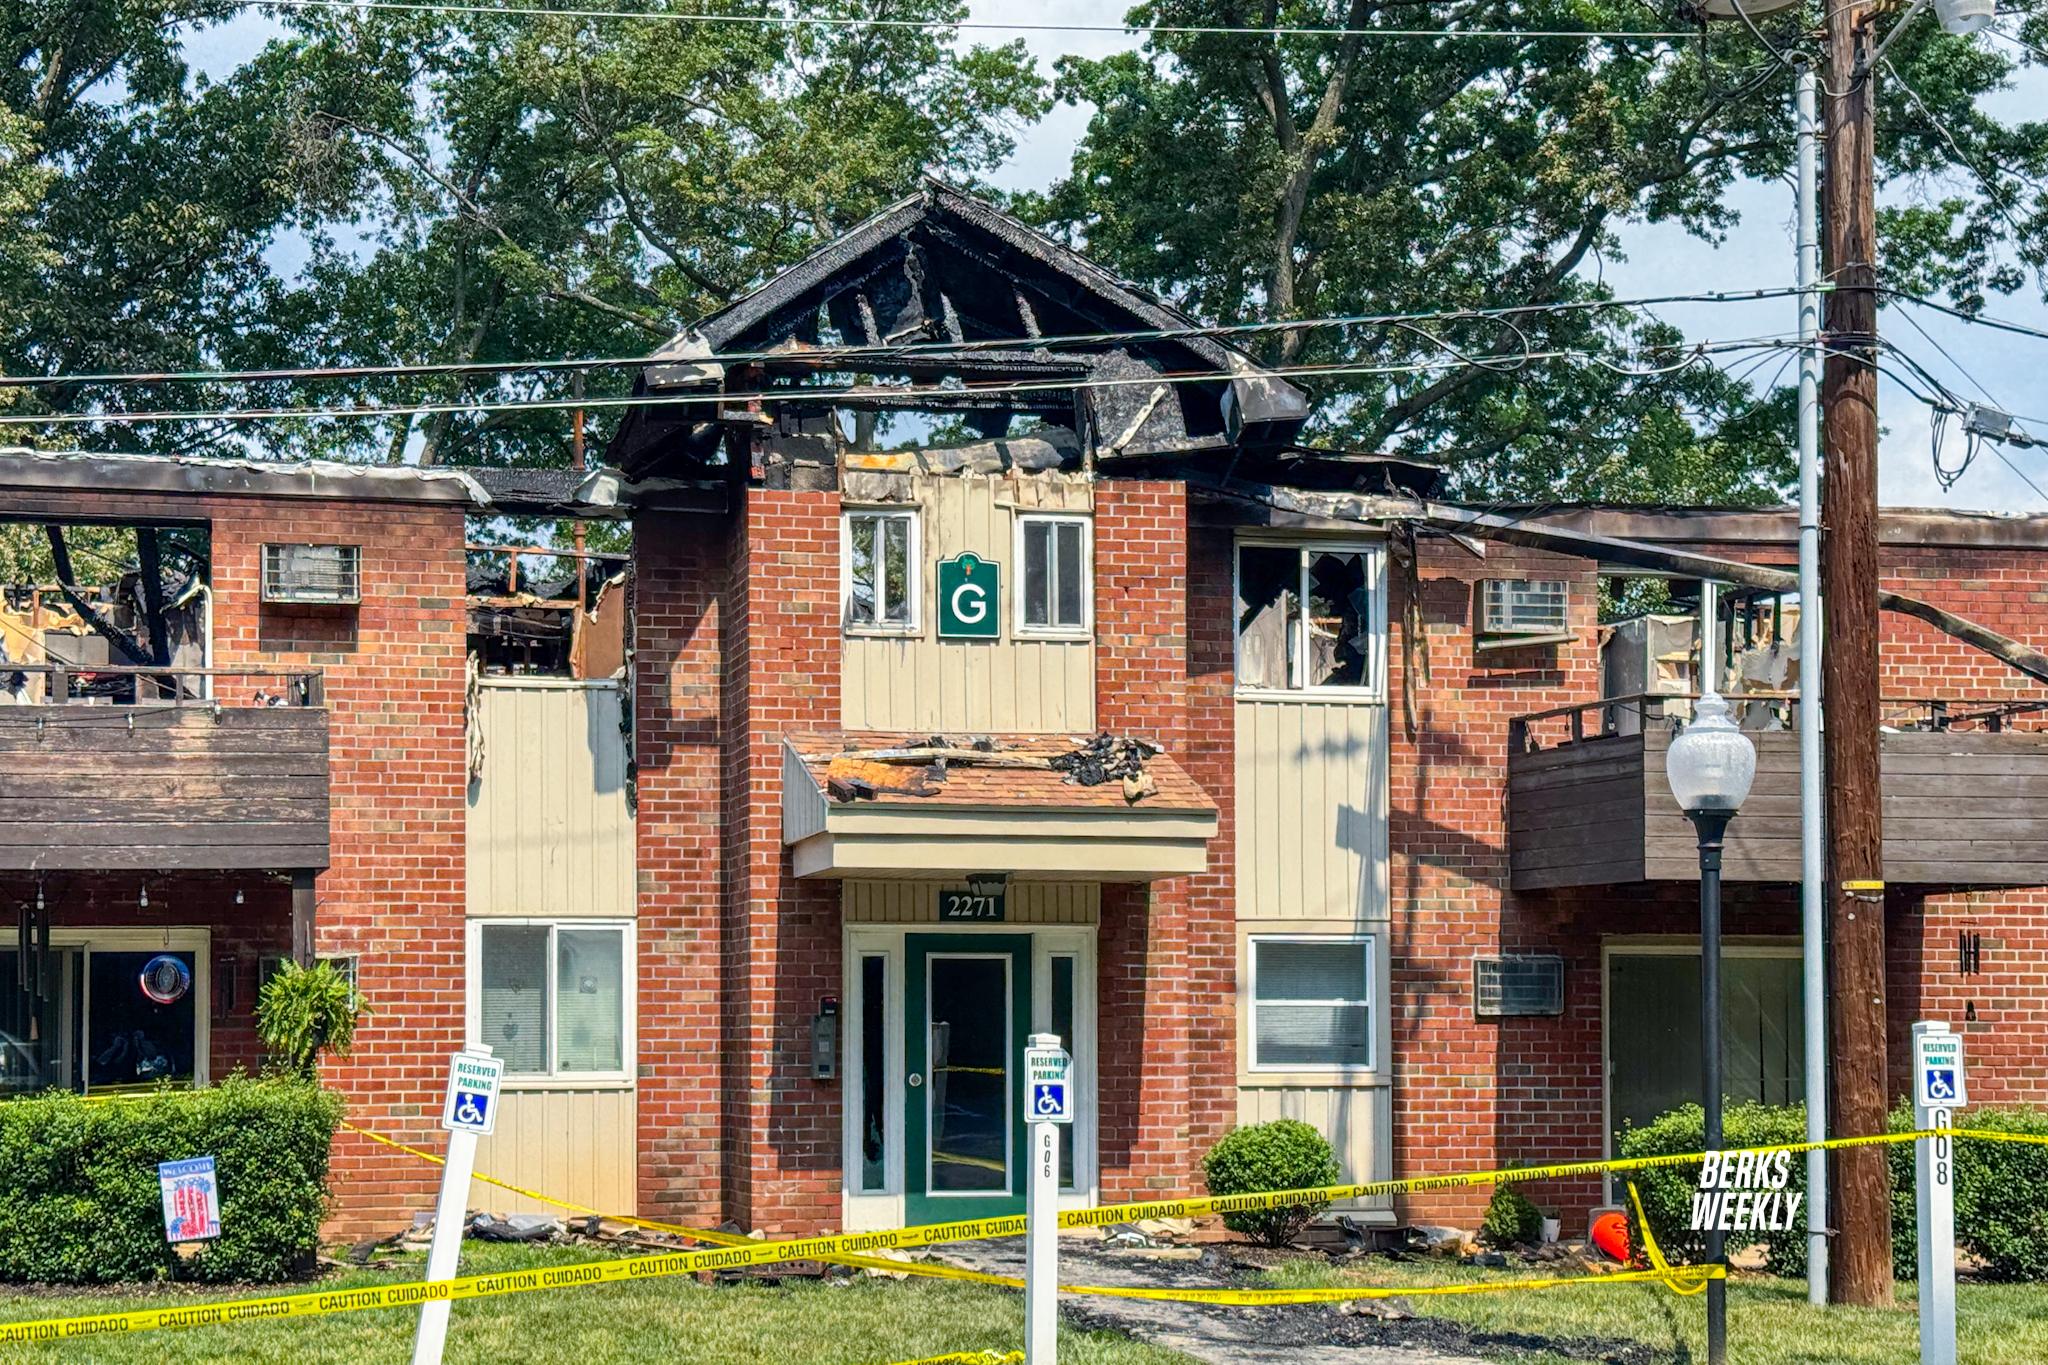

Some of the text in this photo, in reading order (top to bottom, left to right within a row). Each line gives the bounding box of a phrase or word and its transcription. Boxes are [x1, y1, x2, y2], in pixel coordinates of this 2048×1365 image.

[951, 583, 987, 624] G
[948, 895, 997, 917] 2271
[1923, 1043, 1957, 1053] RESERVED
[1031, 1056, 1068, 1067] RESERVED
[1925, 1056, 1955, 1066] PARKING
[457, 1063, 497, 1078] RESERVED
[1033, 1070, 1066, 1080] PARKING
[457, 1077, 493, 1091] PARKING
[163, 1162, 212, 1176] WELCOME
[1067, 1208, 1124, 1226] CAUTION
[1129, 1203, 1185, 1220] CUIDADO
[1210, 1196, 1267, 1213] CAUTION
[1272, 1190, 1328, 1207] CUIDADO
[1353, 1182, 1409, 1198] CAUTION
[1494, 1168, 1550, 1185] CAUTION
[66, 1317, 129, 1336] CUIDADO
[158, 1308, 222, 1327] CAUTION
[228, 1301, 290, 1320] CUIDADO
[319, 1291, 381, 1310] CAUTION
[387, 1284, 448, 1303] CUIDADO
[476, 1274, 537, 1293] CAUTION
[543, 1267, 601, 1285] CUIDADO
[629, 1257, 688, 1276] CAUTION
[694, 1250, 752, 1268] CUIDADO
[778, 1239, 836, 1259] CAUTION
[841, 1233, 898, 1251] CUIDADO
[924, 1224, 980, 1242] CAUTION
